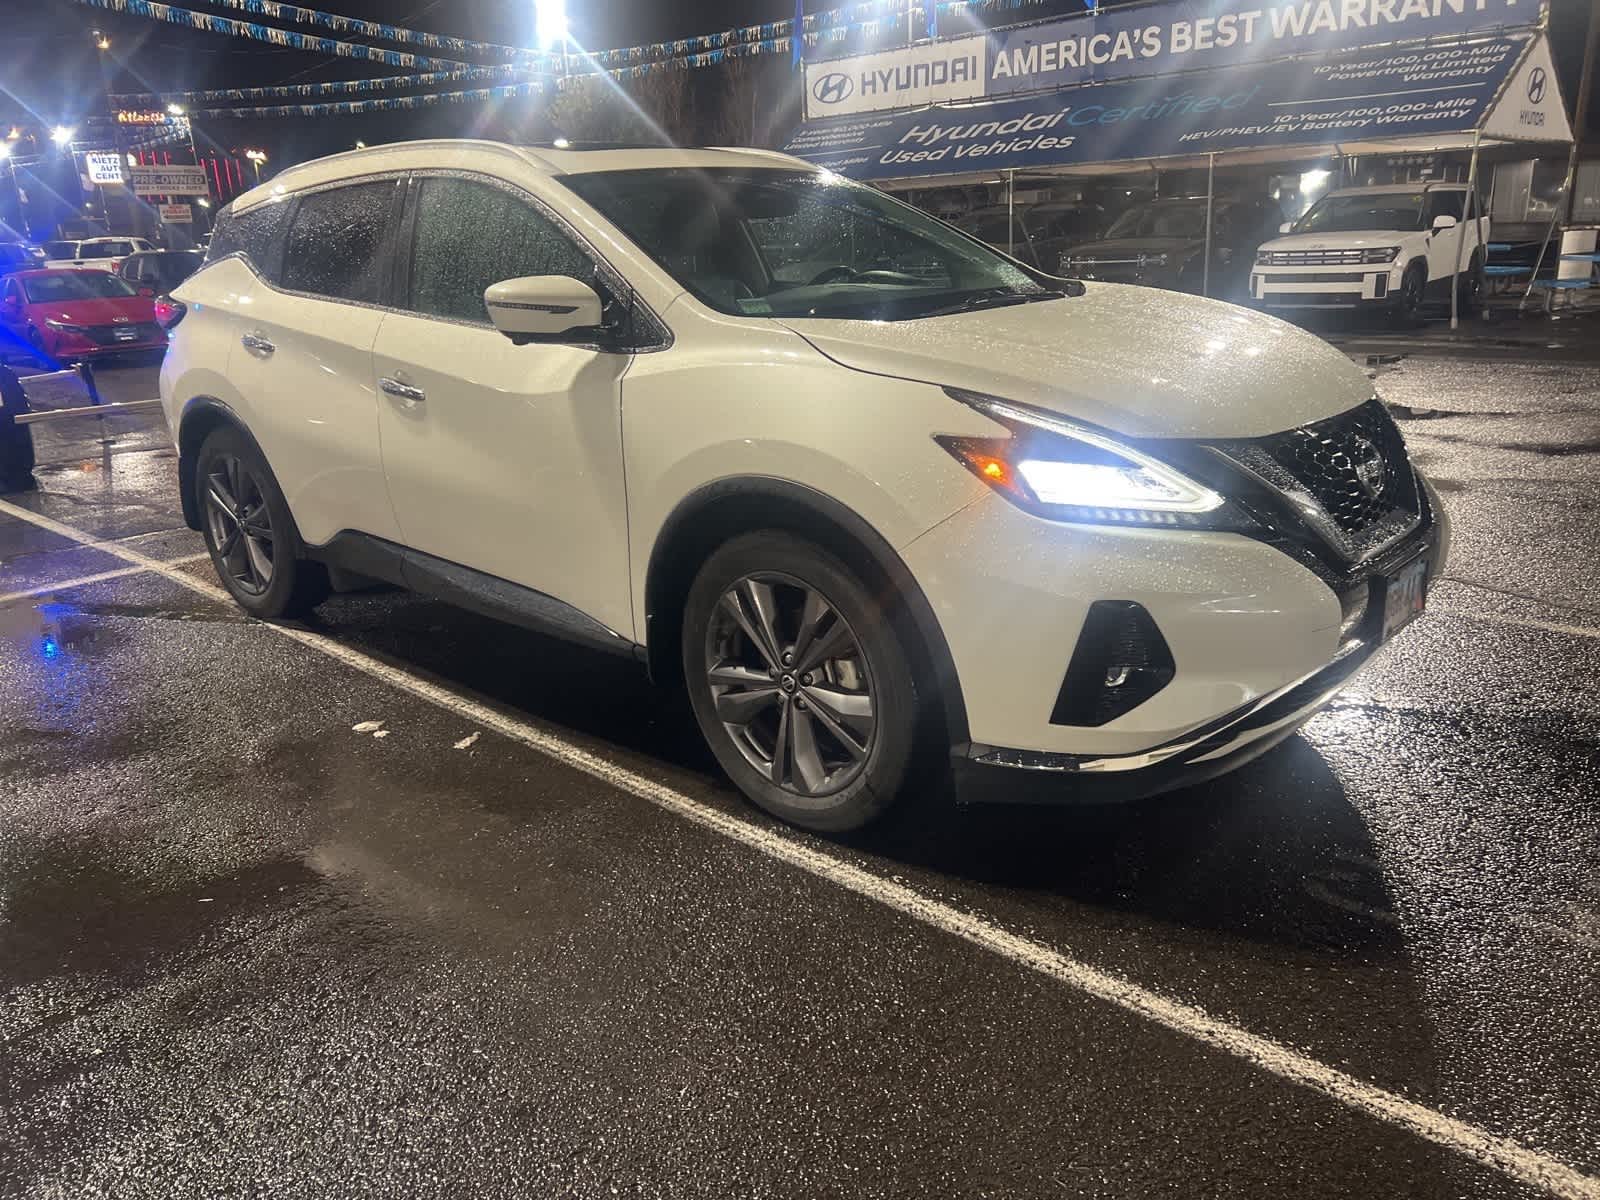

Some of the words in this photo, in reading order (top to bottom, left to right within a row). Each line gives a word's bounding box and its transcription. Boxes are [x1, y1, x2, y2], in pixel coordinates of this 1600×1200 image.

[991, 25, 1162, 79] AMERICA'S
[1170, 10, 1262, 54] BEST
[861, 55, 977, 96] HYUNDAI
[1327, 63, 1428, 81] Powertrain
[1431, 53, 1507, 70] Limited
[1403, 64, 1497, 82] Warranty
[899, 106, 1072, 147] Hyundai
[1066, 80, 1266, 127] Certified
[1302, 117, 1373, 131] Battery
[1376, 108, 1472, 125] Warranty
[879, 147, 949, 164] Used
[954, 134, 1077, 159] Vehicles
[131, 174, 205, 185] PRE-OWNED
